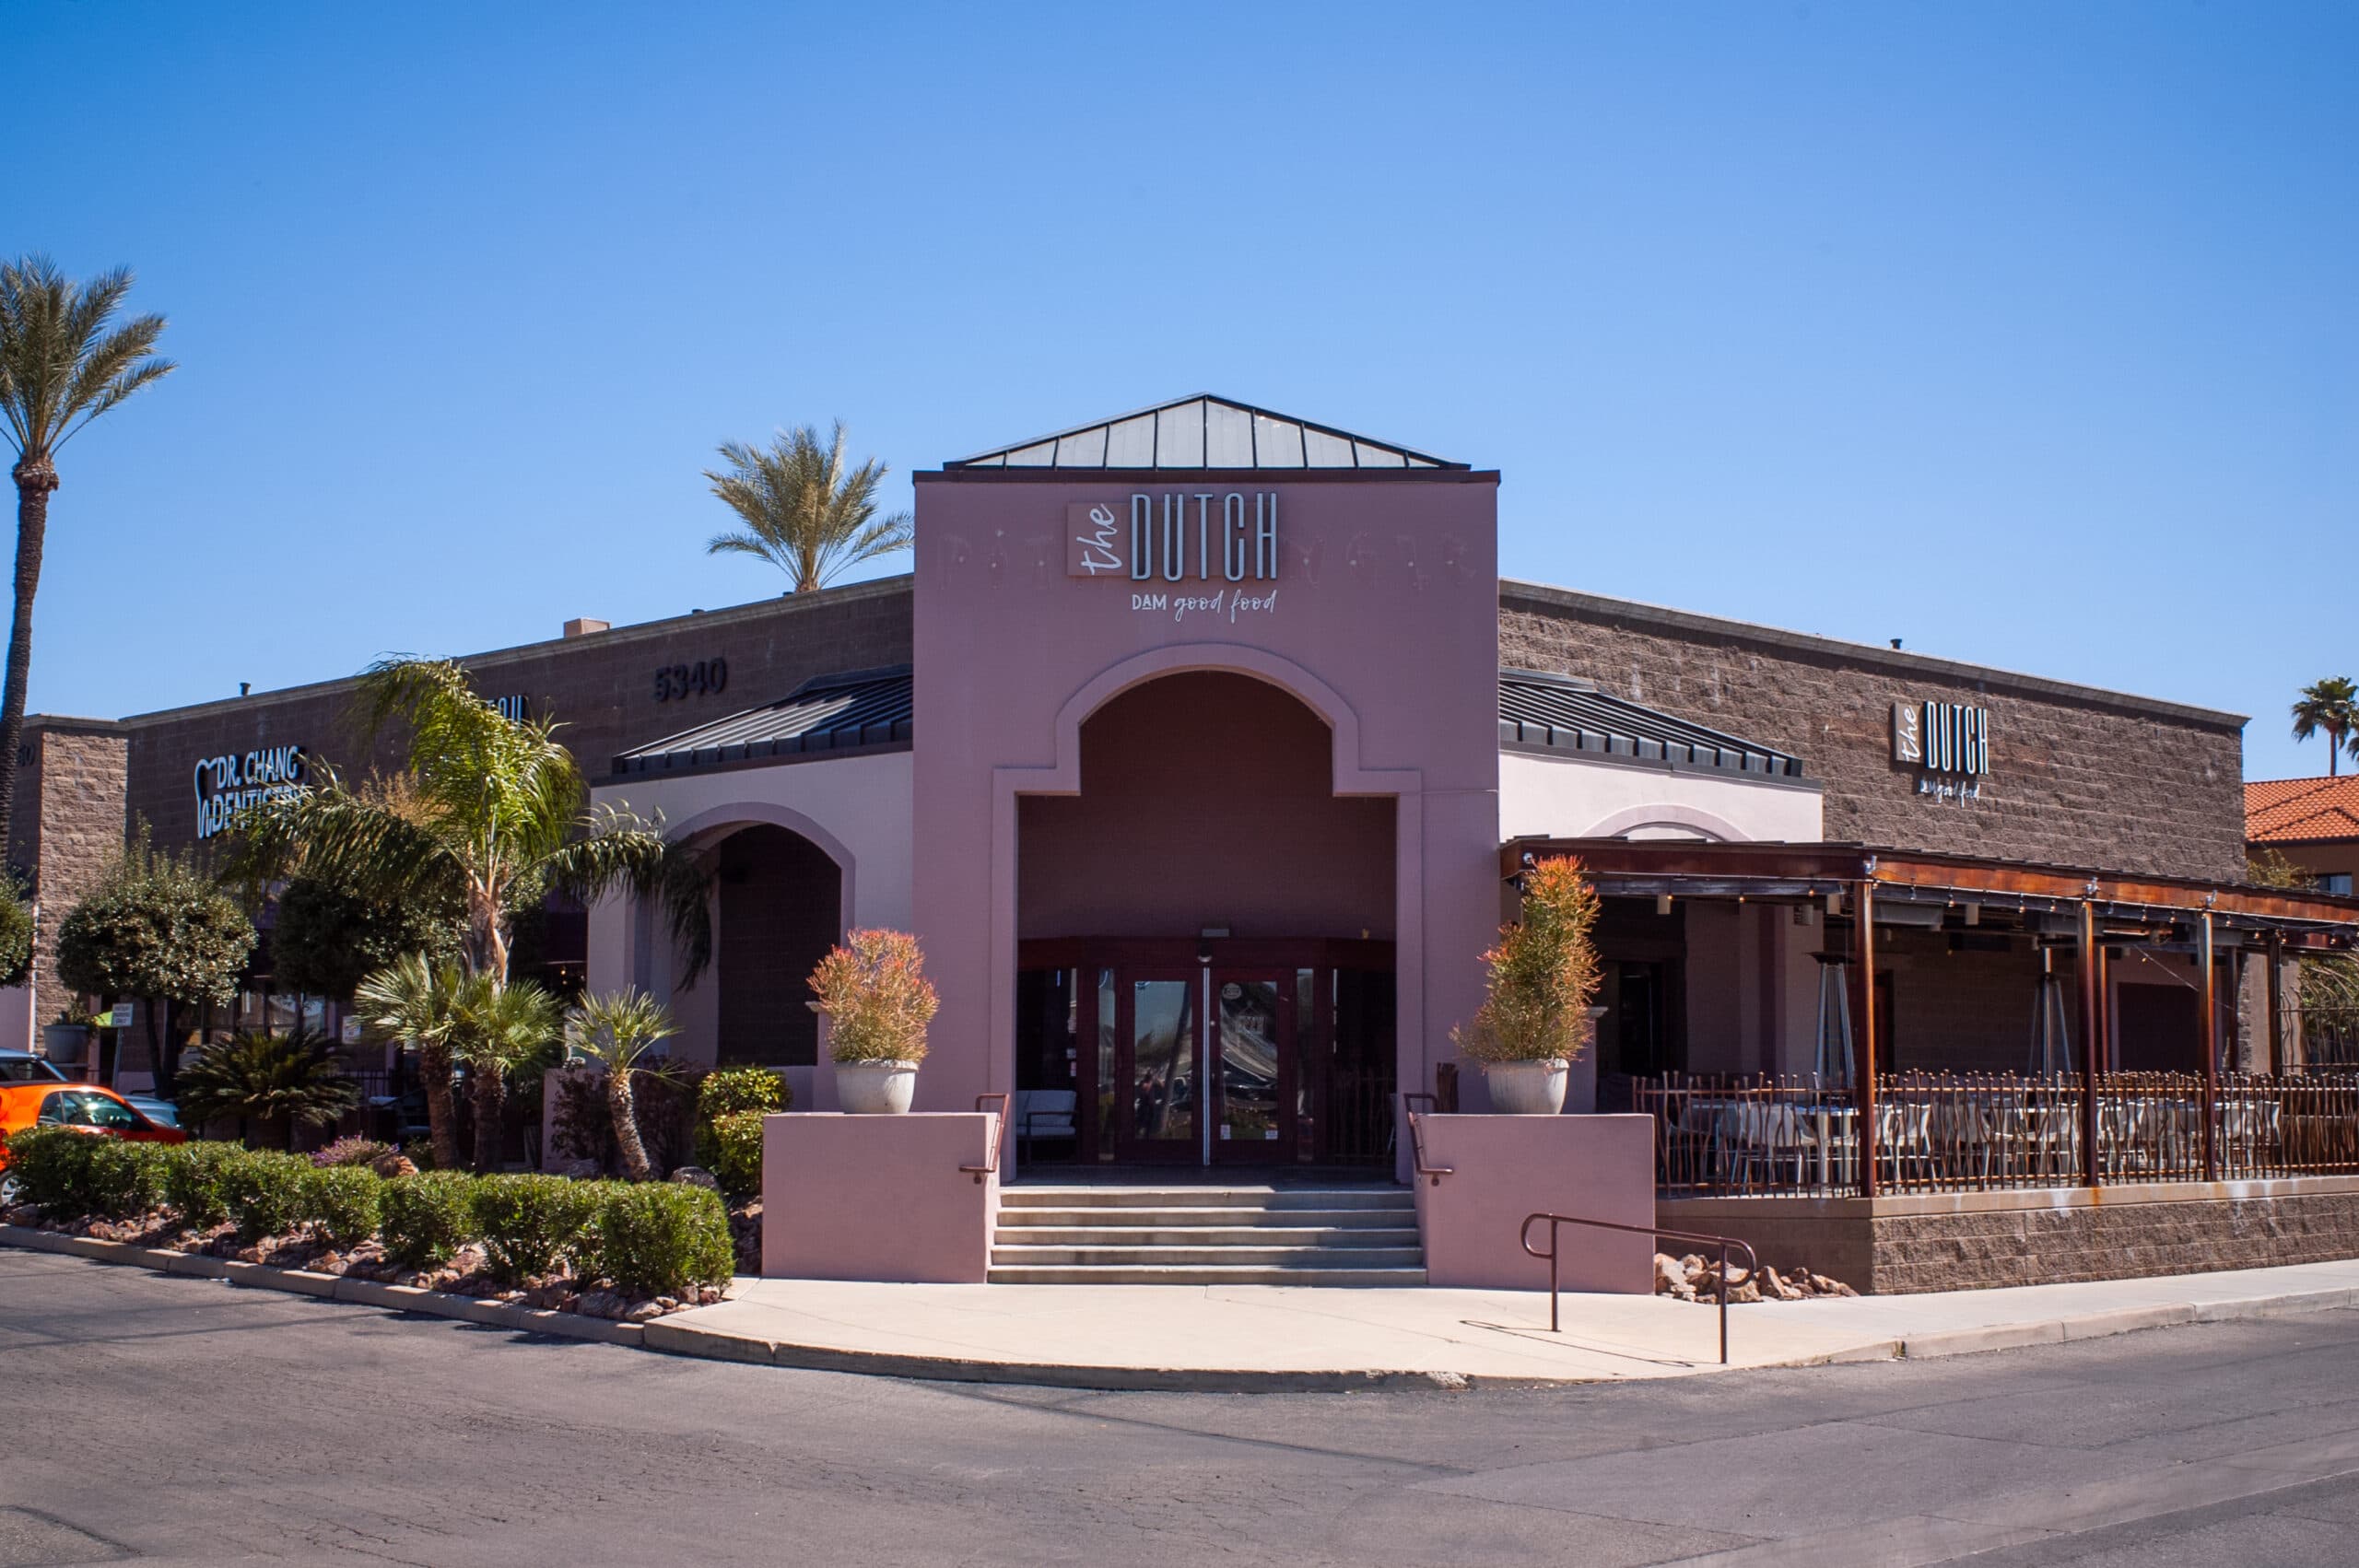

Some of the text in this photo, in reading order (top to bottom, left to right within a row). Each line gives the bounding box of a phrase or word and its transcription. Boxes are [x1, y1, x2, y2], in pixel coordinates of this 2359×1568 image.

[1076, 492, 1278, 582] the DUTCH
[1131, 589, 1278, 624] DAM good food
[654, 655, 728, 702] 5340
[1898, 700, 1989, 775] the DUTCH
[244, 745, 299, 784] CHANG
